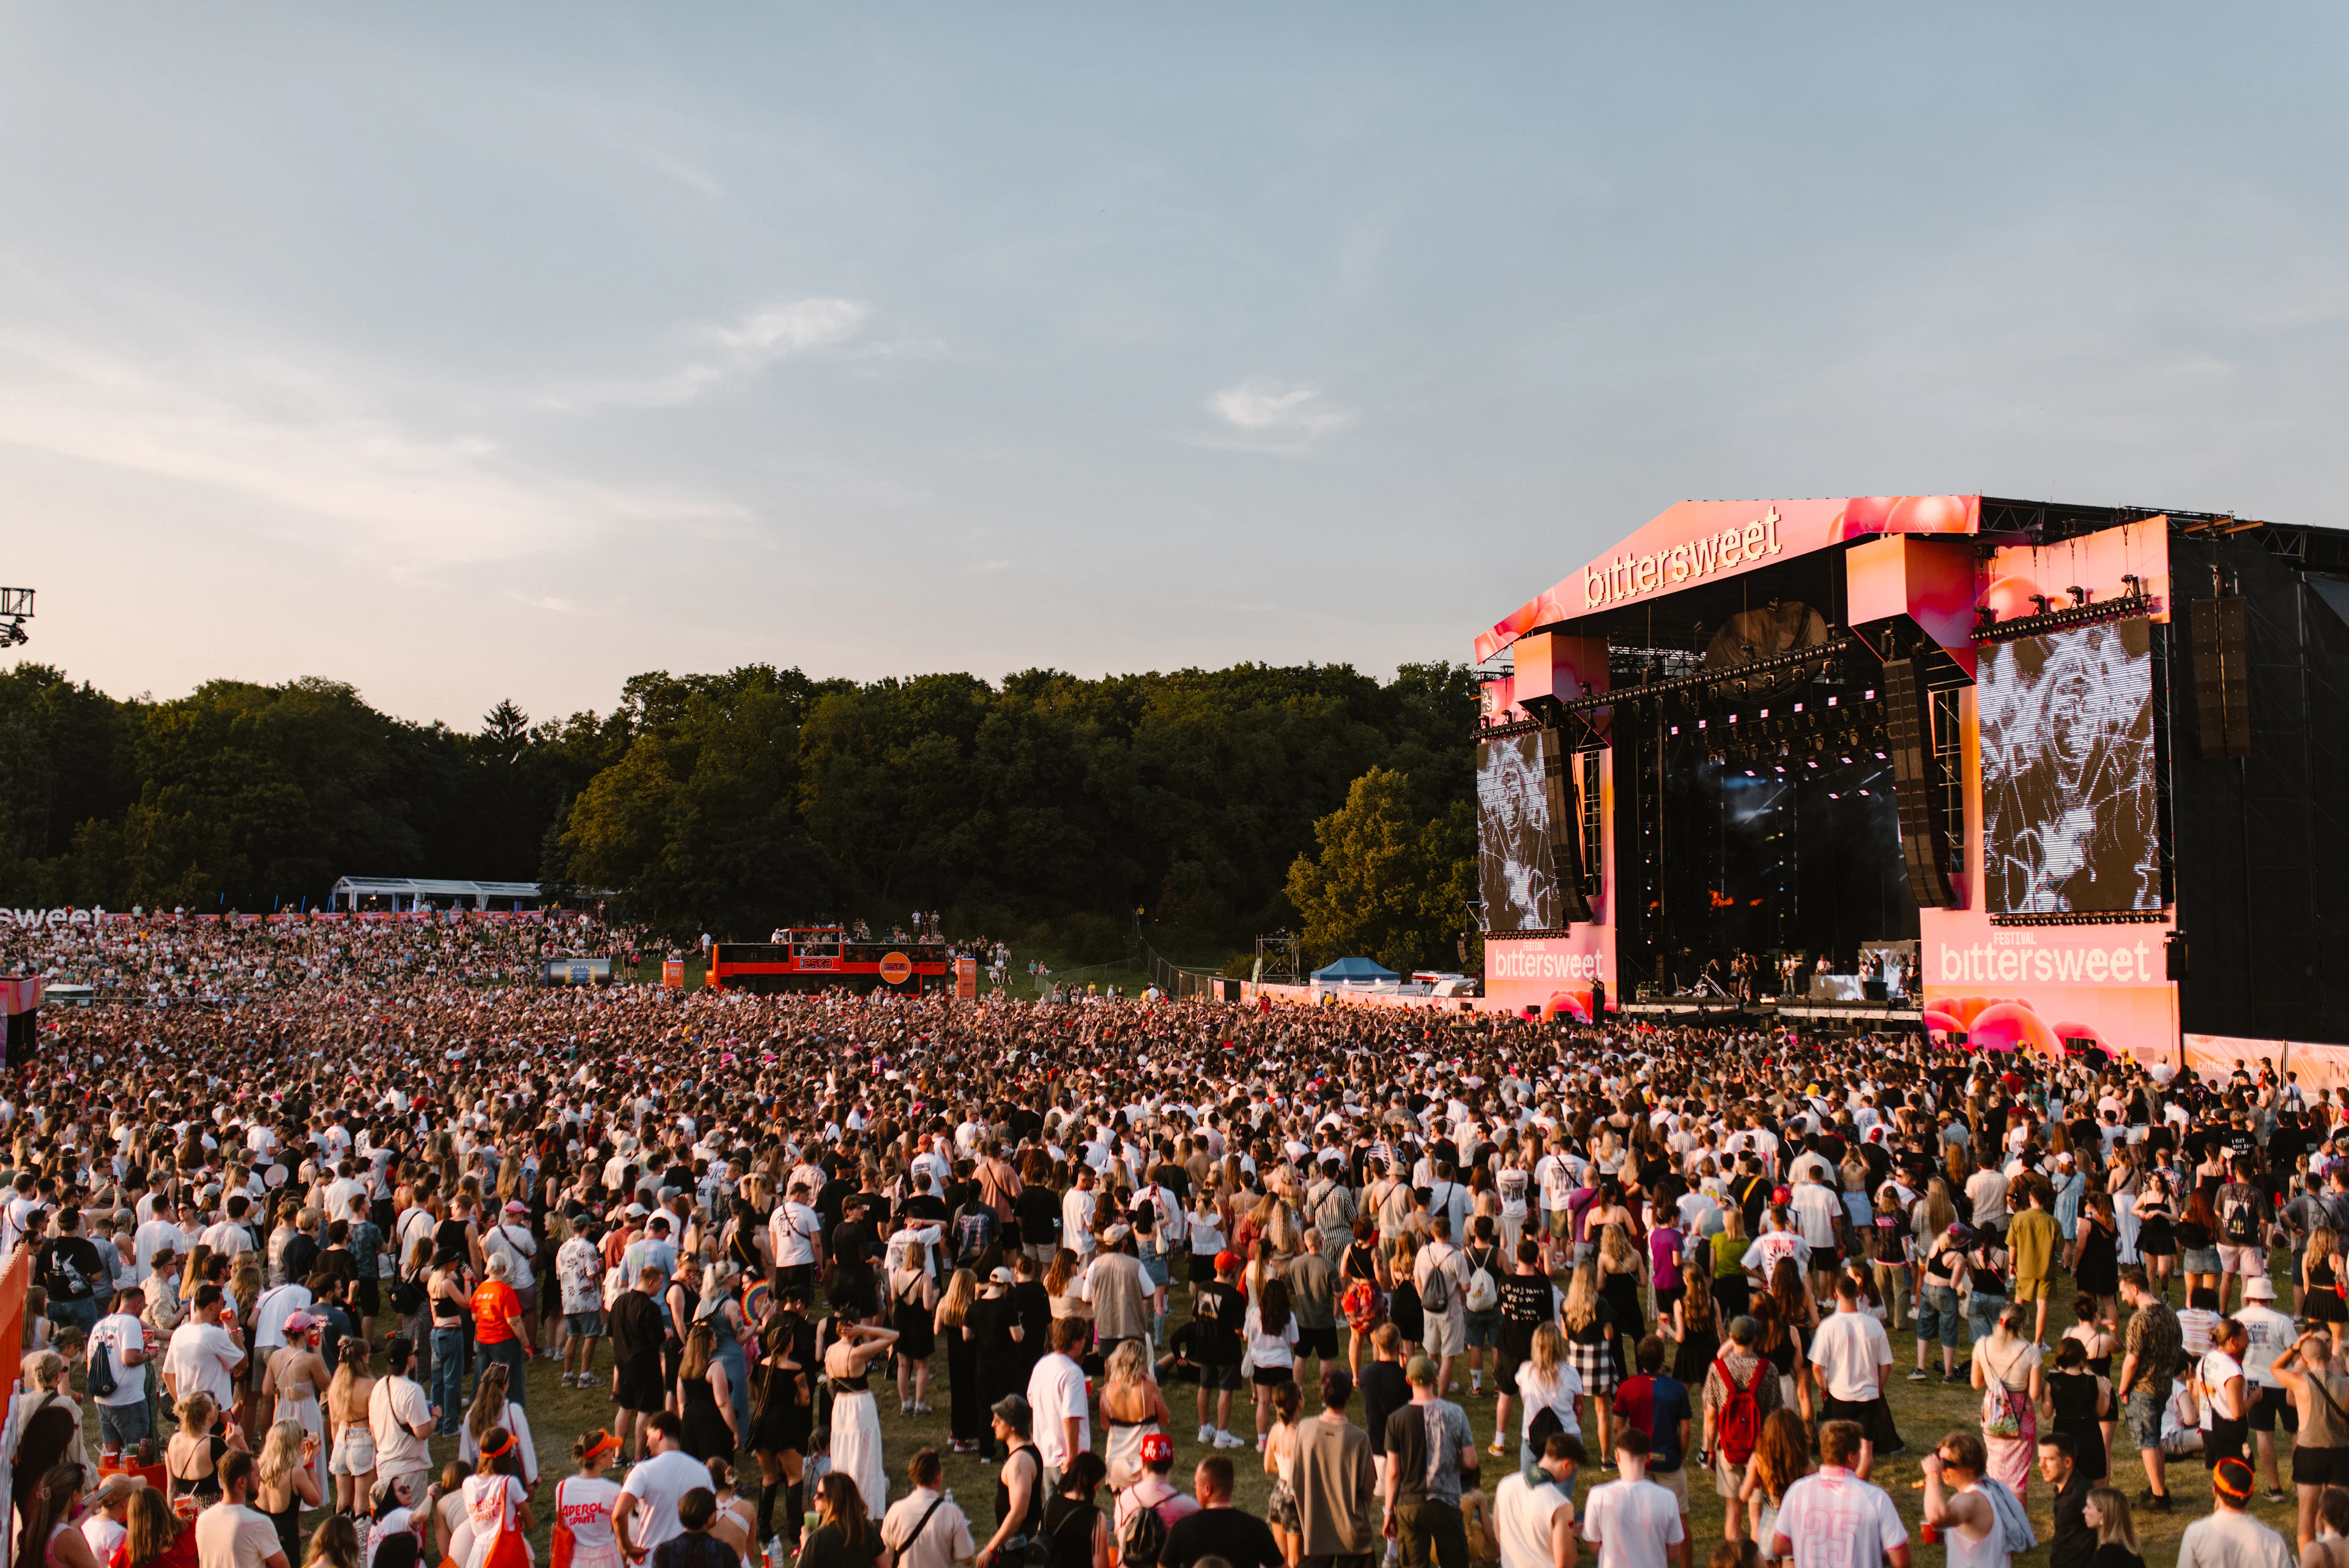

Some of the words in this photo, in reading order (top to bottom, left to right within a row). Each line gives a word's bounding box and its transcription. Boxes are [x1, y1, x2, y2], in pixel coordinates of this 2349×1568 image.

[1584, 505, 1783, 609] bittersweet
[1523, 941, 1546, 952] FESTIVAL
[1994, 931, 2037, 946] FESTIVAL
[1495, 948, 1603, 978] bittersweet
[1941, 940, 2151, 982] bittersweet
[2326, 1061, 2349, 1079] Th
[2198, 1091, 2204, 1102] 3
[469, 1495, 501, 1515] APEROL
[563, 1502, 604, 1517] APEROL
[473, 1509, 497, 1523] SPRITZ
[569, 1514, 596, 1526] SPRITZ
[1802, 1509, 1862, 1568] 25
